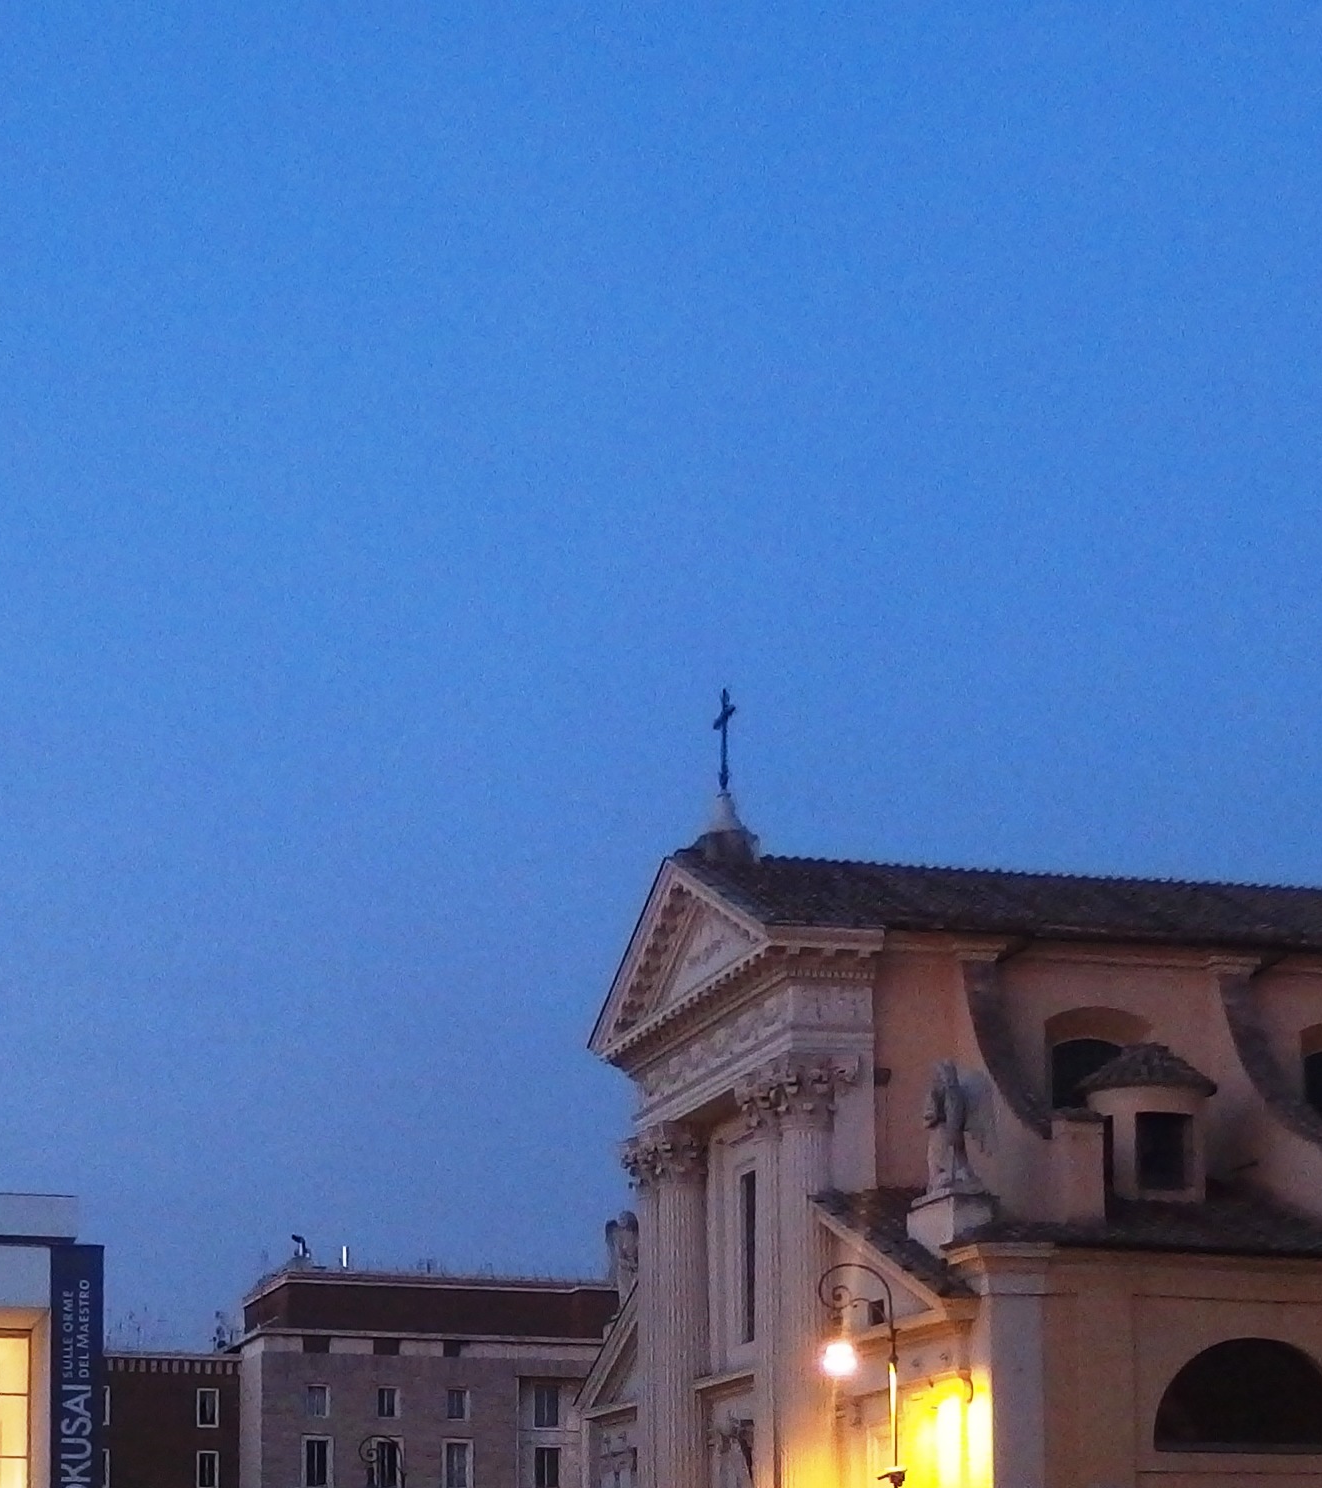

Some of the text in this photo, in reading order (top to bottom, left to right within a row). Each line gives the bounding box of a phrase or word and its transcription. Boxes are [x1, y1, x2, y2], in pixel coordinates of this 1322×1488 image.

[62, 1290, 74, 1378] SULLE ORME
[76, 1279, 90, 1378] DEL MAESTRO
